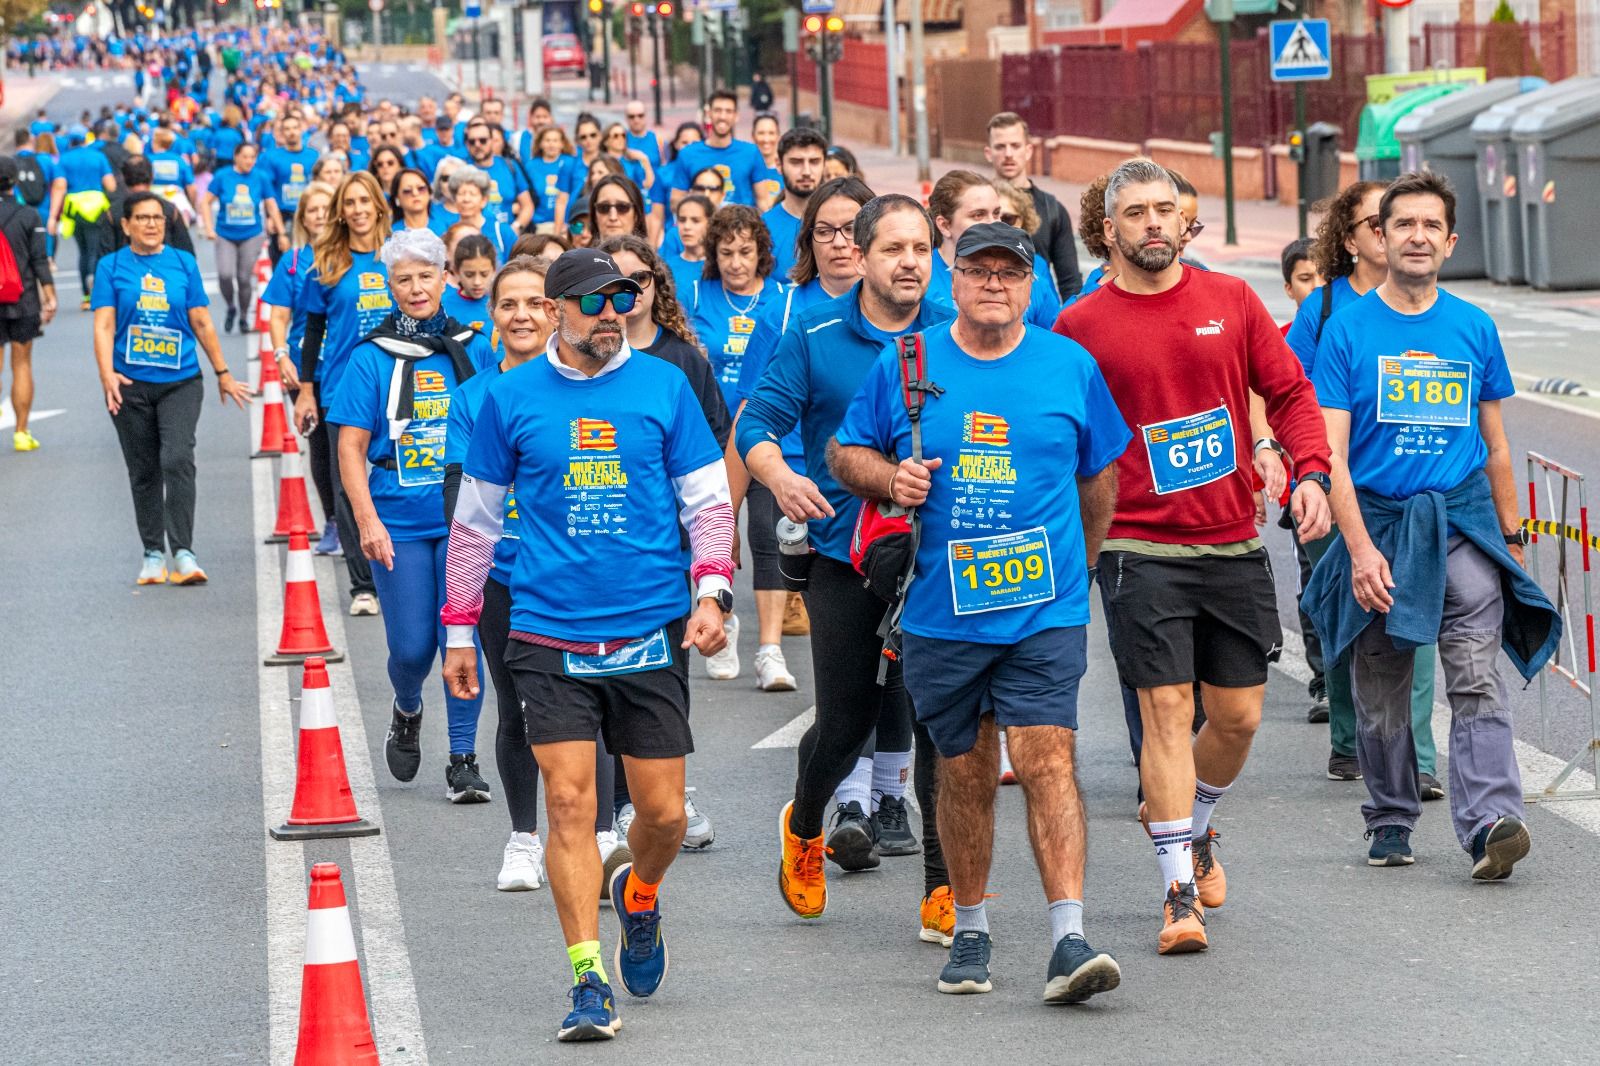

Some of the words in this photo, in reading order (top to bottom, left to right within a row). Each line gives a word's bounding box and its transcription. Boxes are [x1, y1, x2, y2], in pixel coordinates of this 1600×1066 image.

[1195, 326, 1221, 336] PUMA
[133, 338, 177, 357] 2046
[1387, 379, 1463, 404] 3180
[1168, 434, 1223, 468] 676
[569, 459, 621, 474] MUÉVETE
[959, 453, 1011, 468] MUÉVETE
[951, 466, 960, 478] X
[962, 466, 1017, 481] VALENCIA
[1187, 463, 1214, 474] FUENTES
[563, 474, 571, 486] X
[573, 472, 628, 486] VALENCIA
[962, 554, 1044, 589] 1309
[990, 586, 1021, 596] MARIANO
